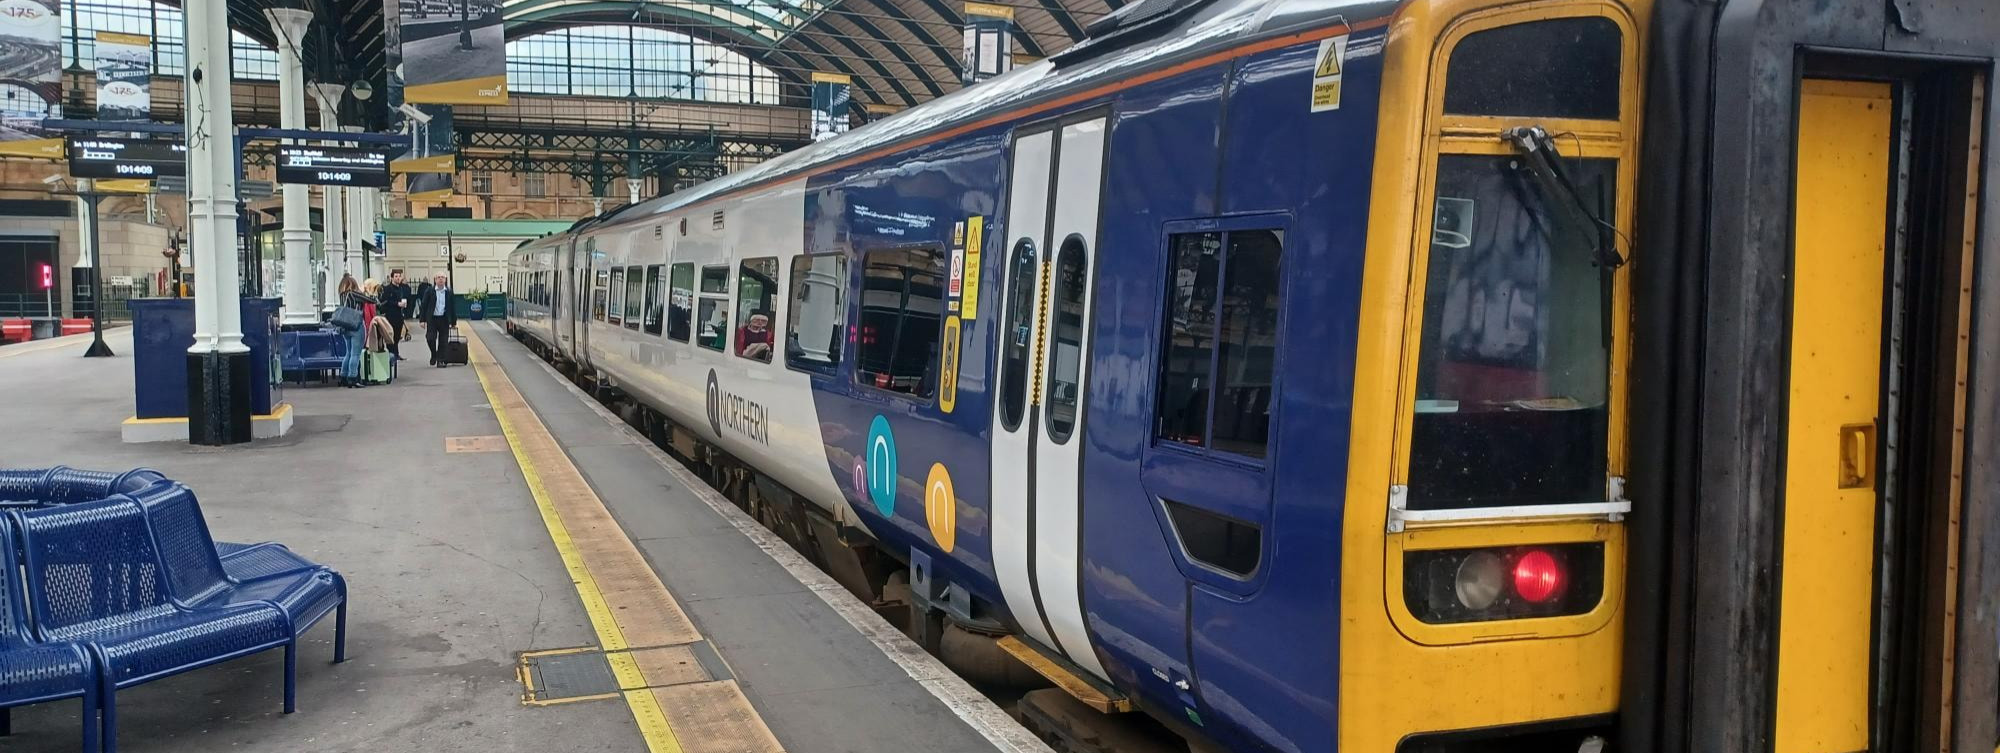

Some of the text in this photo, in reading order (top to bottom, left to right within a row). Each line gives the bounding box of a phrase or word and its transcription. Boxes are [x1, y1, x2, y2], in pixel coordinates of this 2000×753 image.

[9, 7, 35, 18] 175
[114, 86, 132, 96] 175
[1315, 84, 1335, 93] Danger
[116, 164, 153, 175] 10:14:09
[317, 171, 351, 181] 10:14:09
[442, 246, 449, 256] 3
[720, 388, 769, 447] NORTHERN
